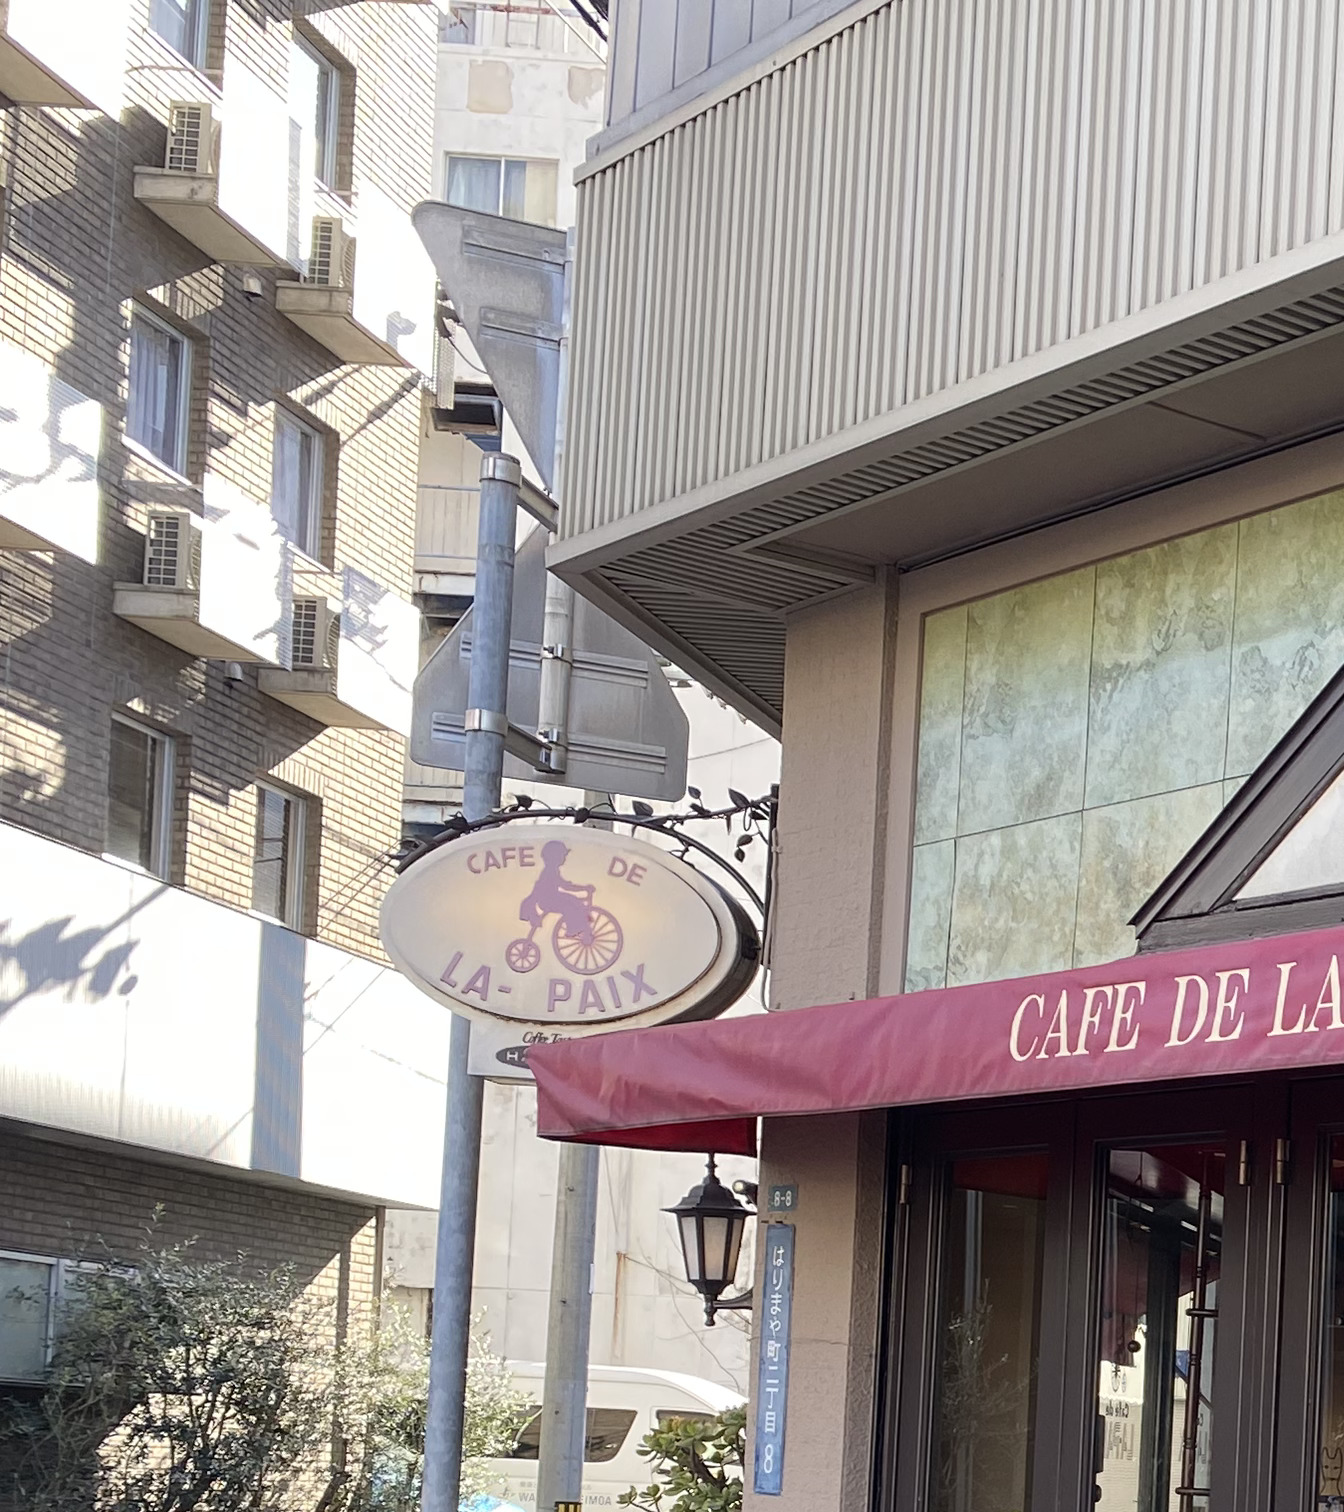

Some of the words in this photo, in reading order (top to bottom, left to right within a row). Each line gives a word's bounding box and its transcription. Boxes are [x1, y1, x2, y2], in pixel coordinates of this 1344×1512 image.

[467, 846, 536, 874] CAFE
[608, 856, 647, 886] DE
[548, 963, 657, 1015] PAIX
[1009, 980, 1146, 1062] CAFE
[1164, 968, 1251, 1048] DE
[774, 1190, 793, 1207] 8-8
